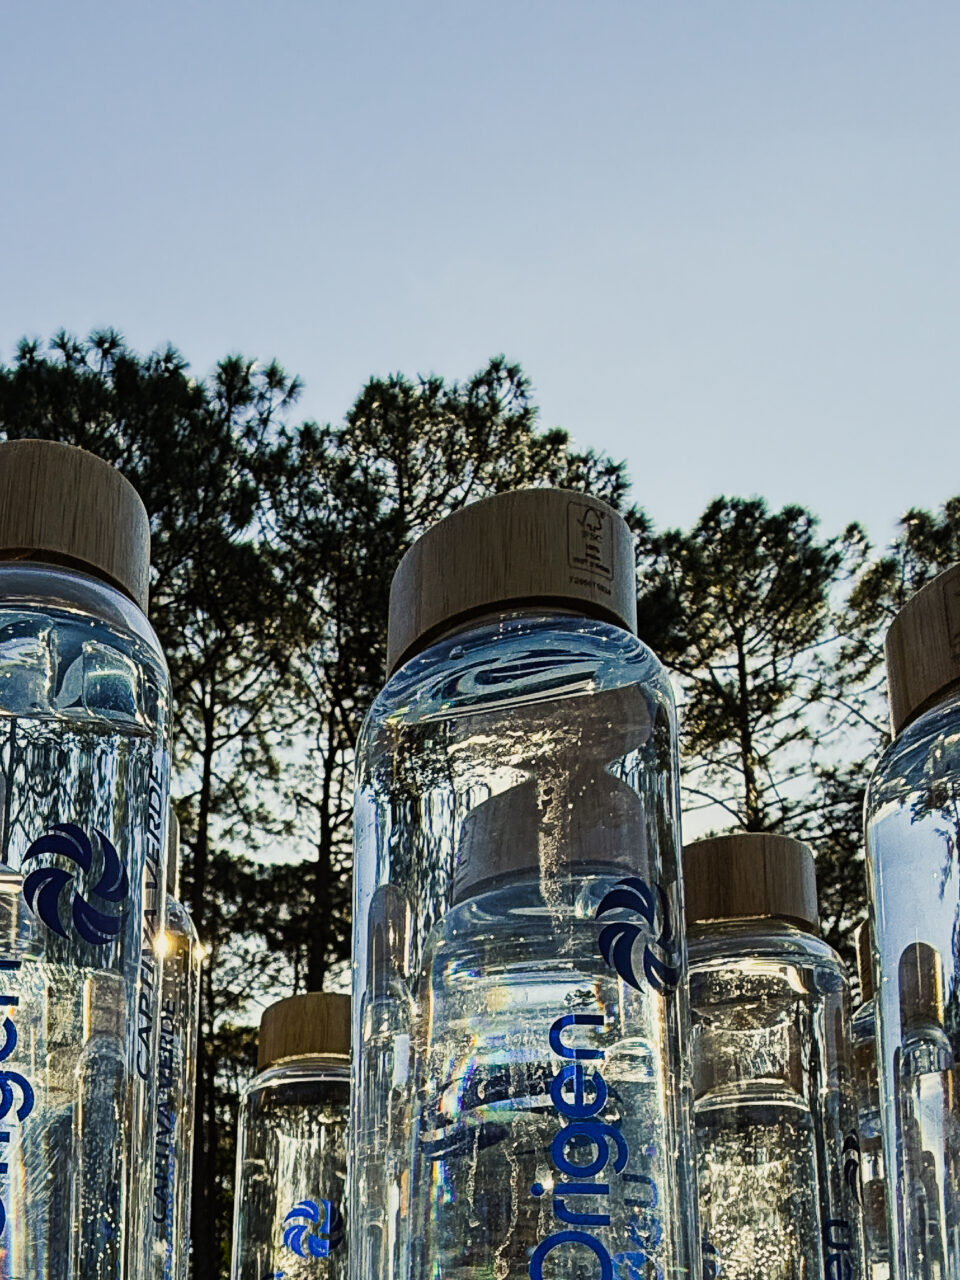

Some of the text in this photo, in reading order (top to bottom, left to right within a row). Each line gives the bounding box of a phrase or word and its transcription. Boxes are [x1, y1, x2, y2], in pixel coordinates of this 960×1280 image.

[134, 761, 165, 1082] CAPTIVA VERDE
[157, 1000, 177, 1092] VERDE
[151, 1099, 173, 1224] CAPTIVA
